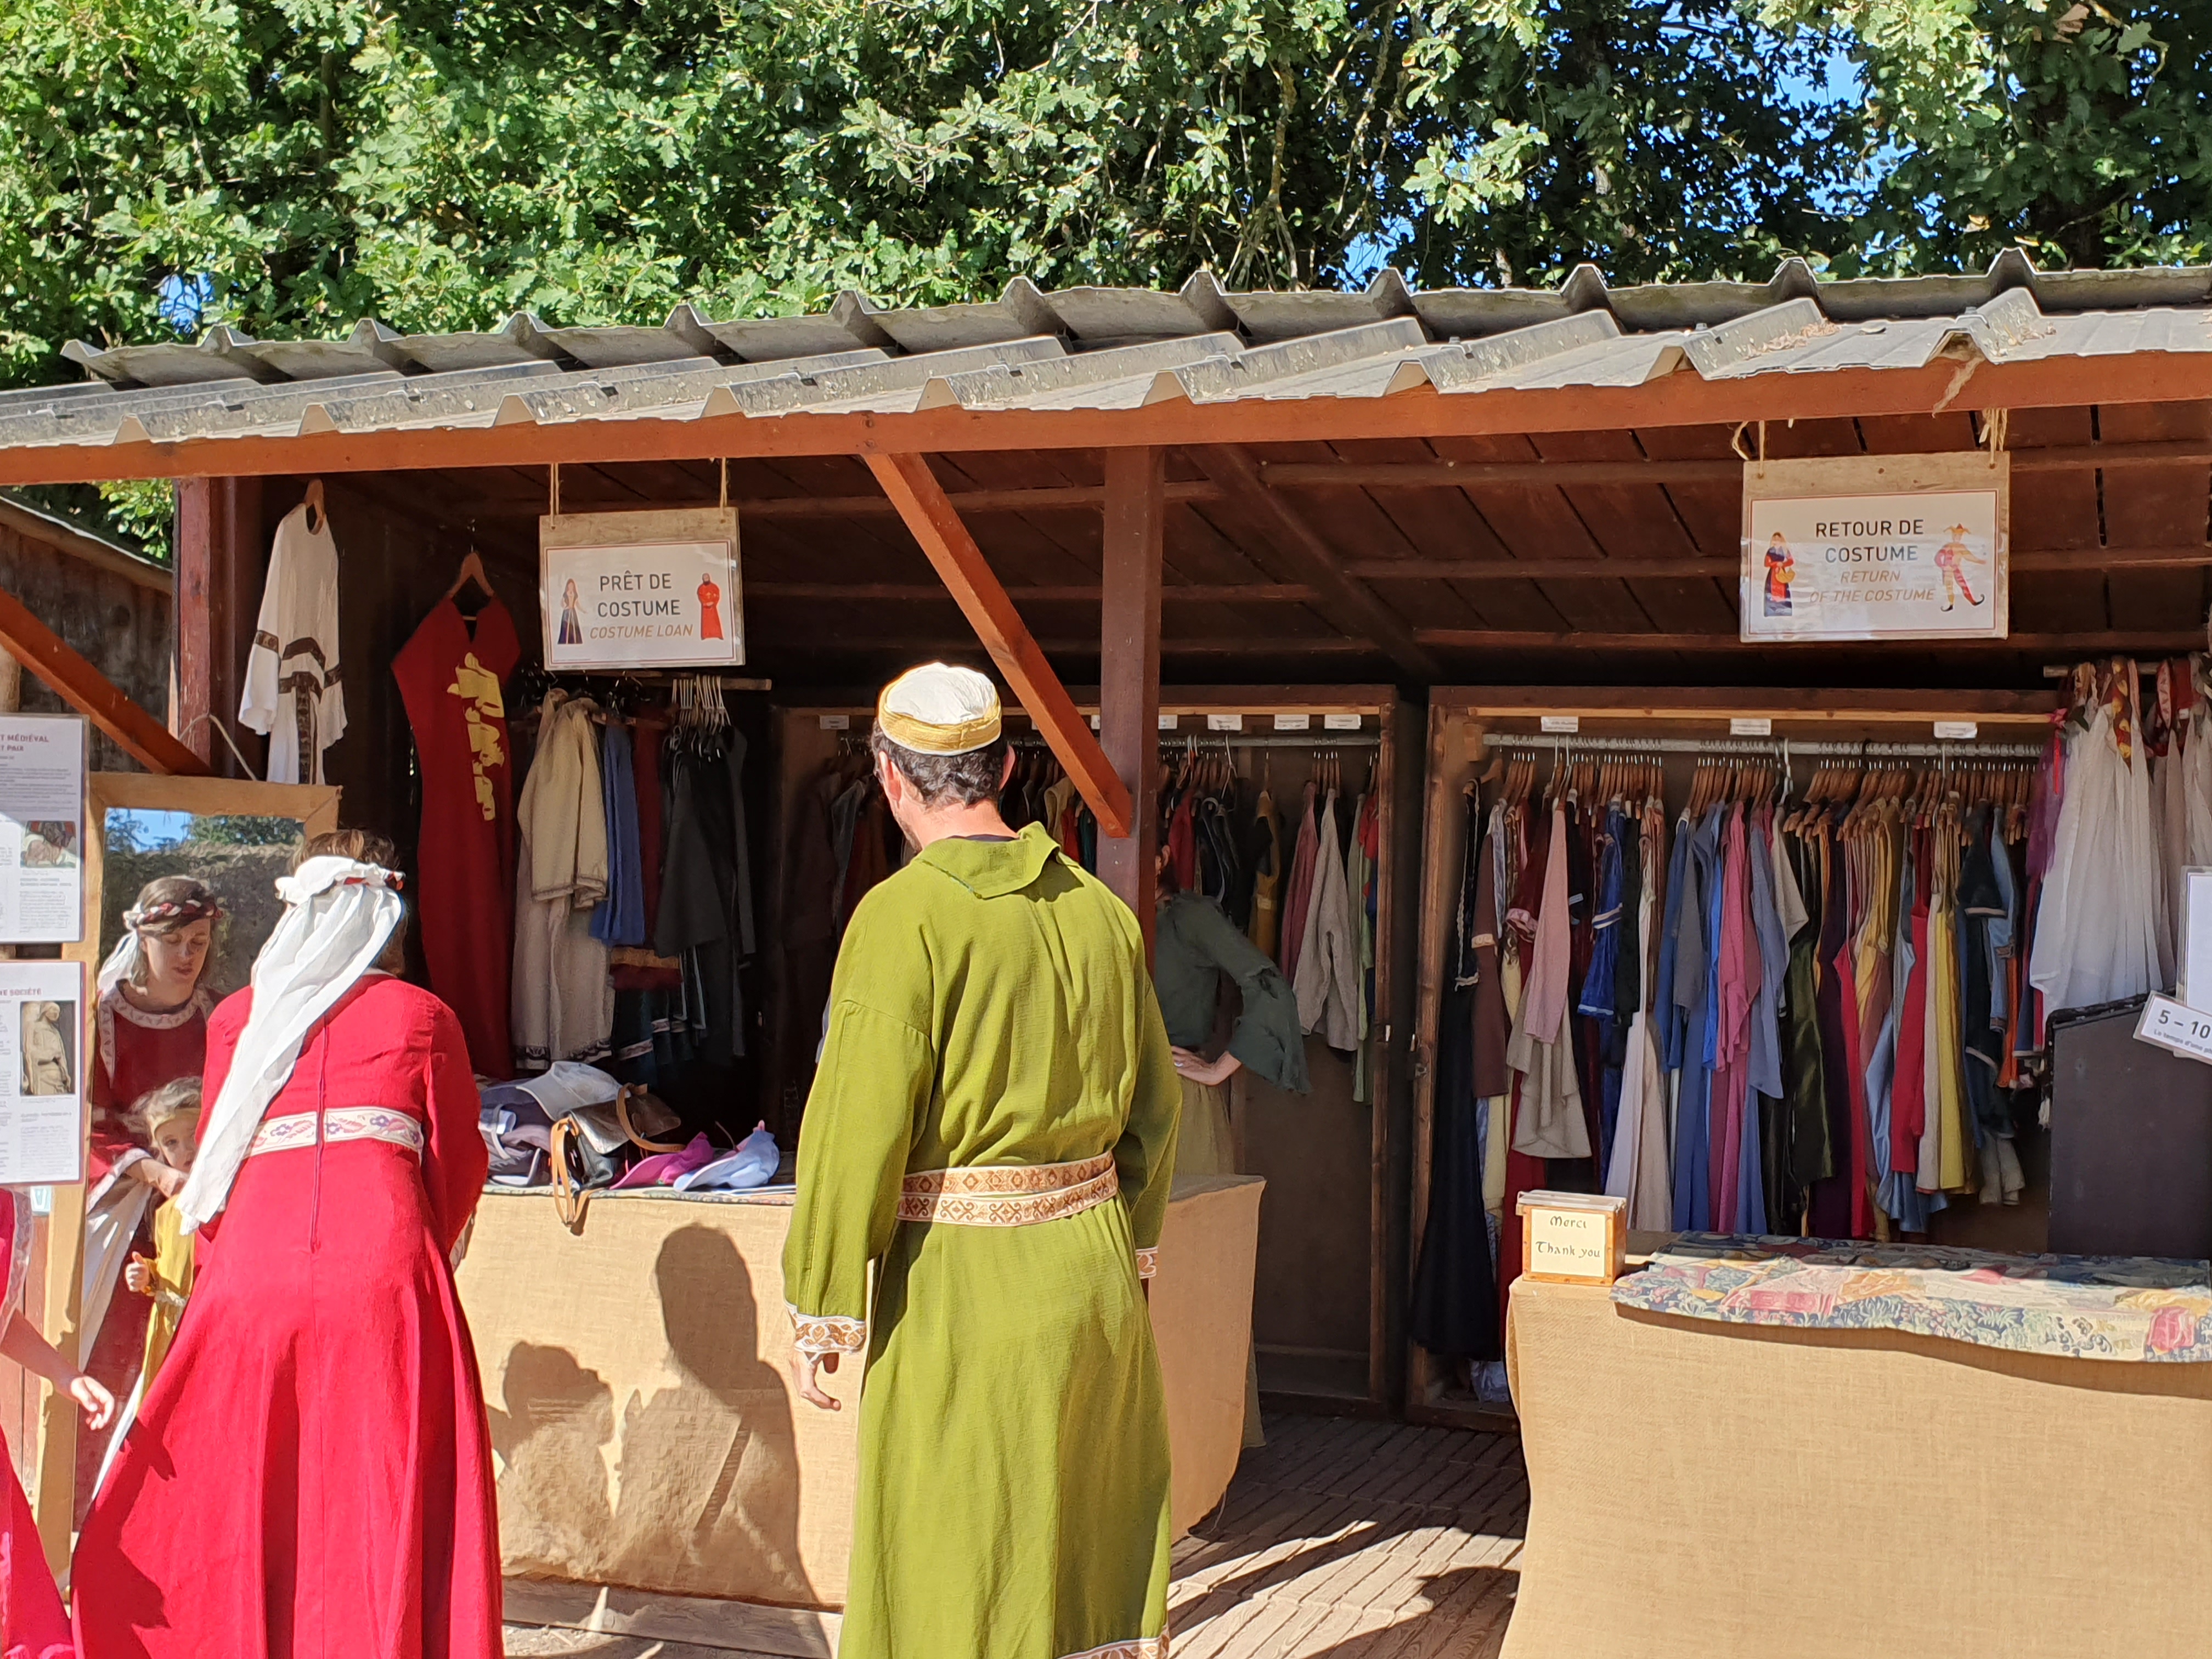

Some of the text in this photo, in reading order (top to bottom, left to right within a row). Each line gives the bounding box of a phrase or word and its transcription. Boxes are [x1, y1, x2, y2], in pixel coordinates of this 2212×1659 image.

[1816, 520, 1924, 538] RETOUR DE
[1825, 546, 1918, 563] COSTUME
[600, 570, 672, 591] PRÊT DE
[1840, 571, 1900, 583] RETURN
[1810, 589, 1936, 603] OF THE COSTUME
[597, 600, 681, 617] COSTUME
[590, 624, 693, 639] COSTUME LOAN
[2158, 1009, 2171, 1025] 5
[2192, 1021, 2211, 1039] 10
[1550, 1216, 1587, 1229] Merci
[1536, 1241, 1600, 1259] Thank you
